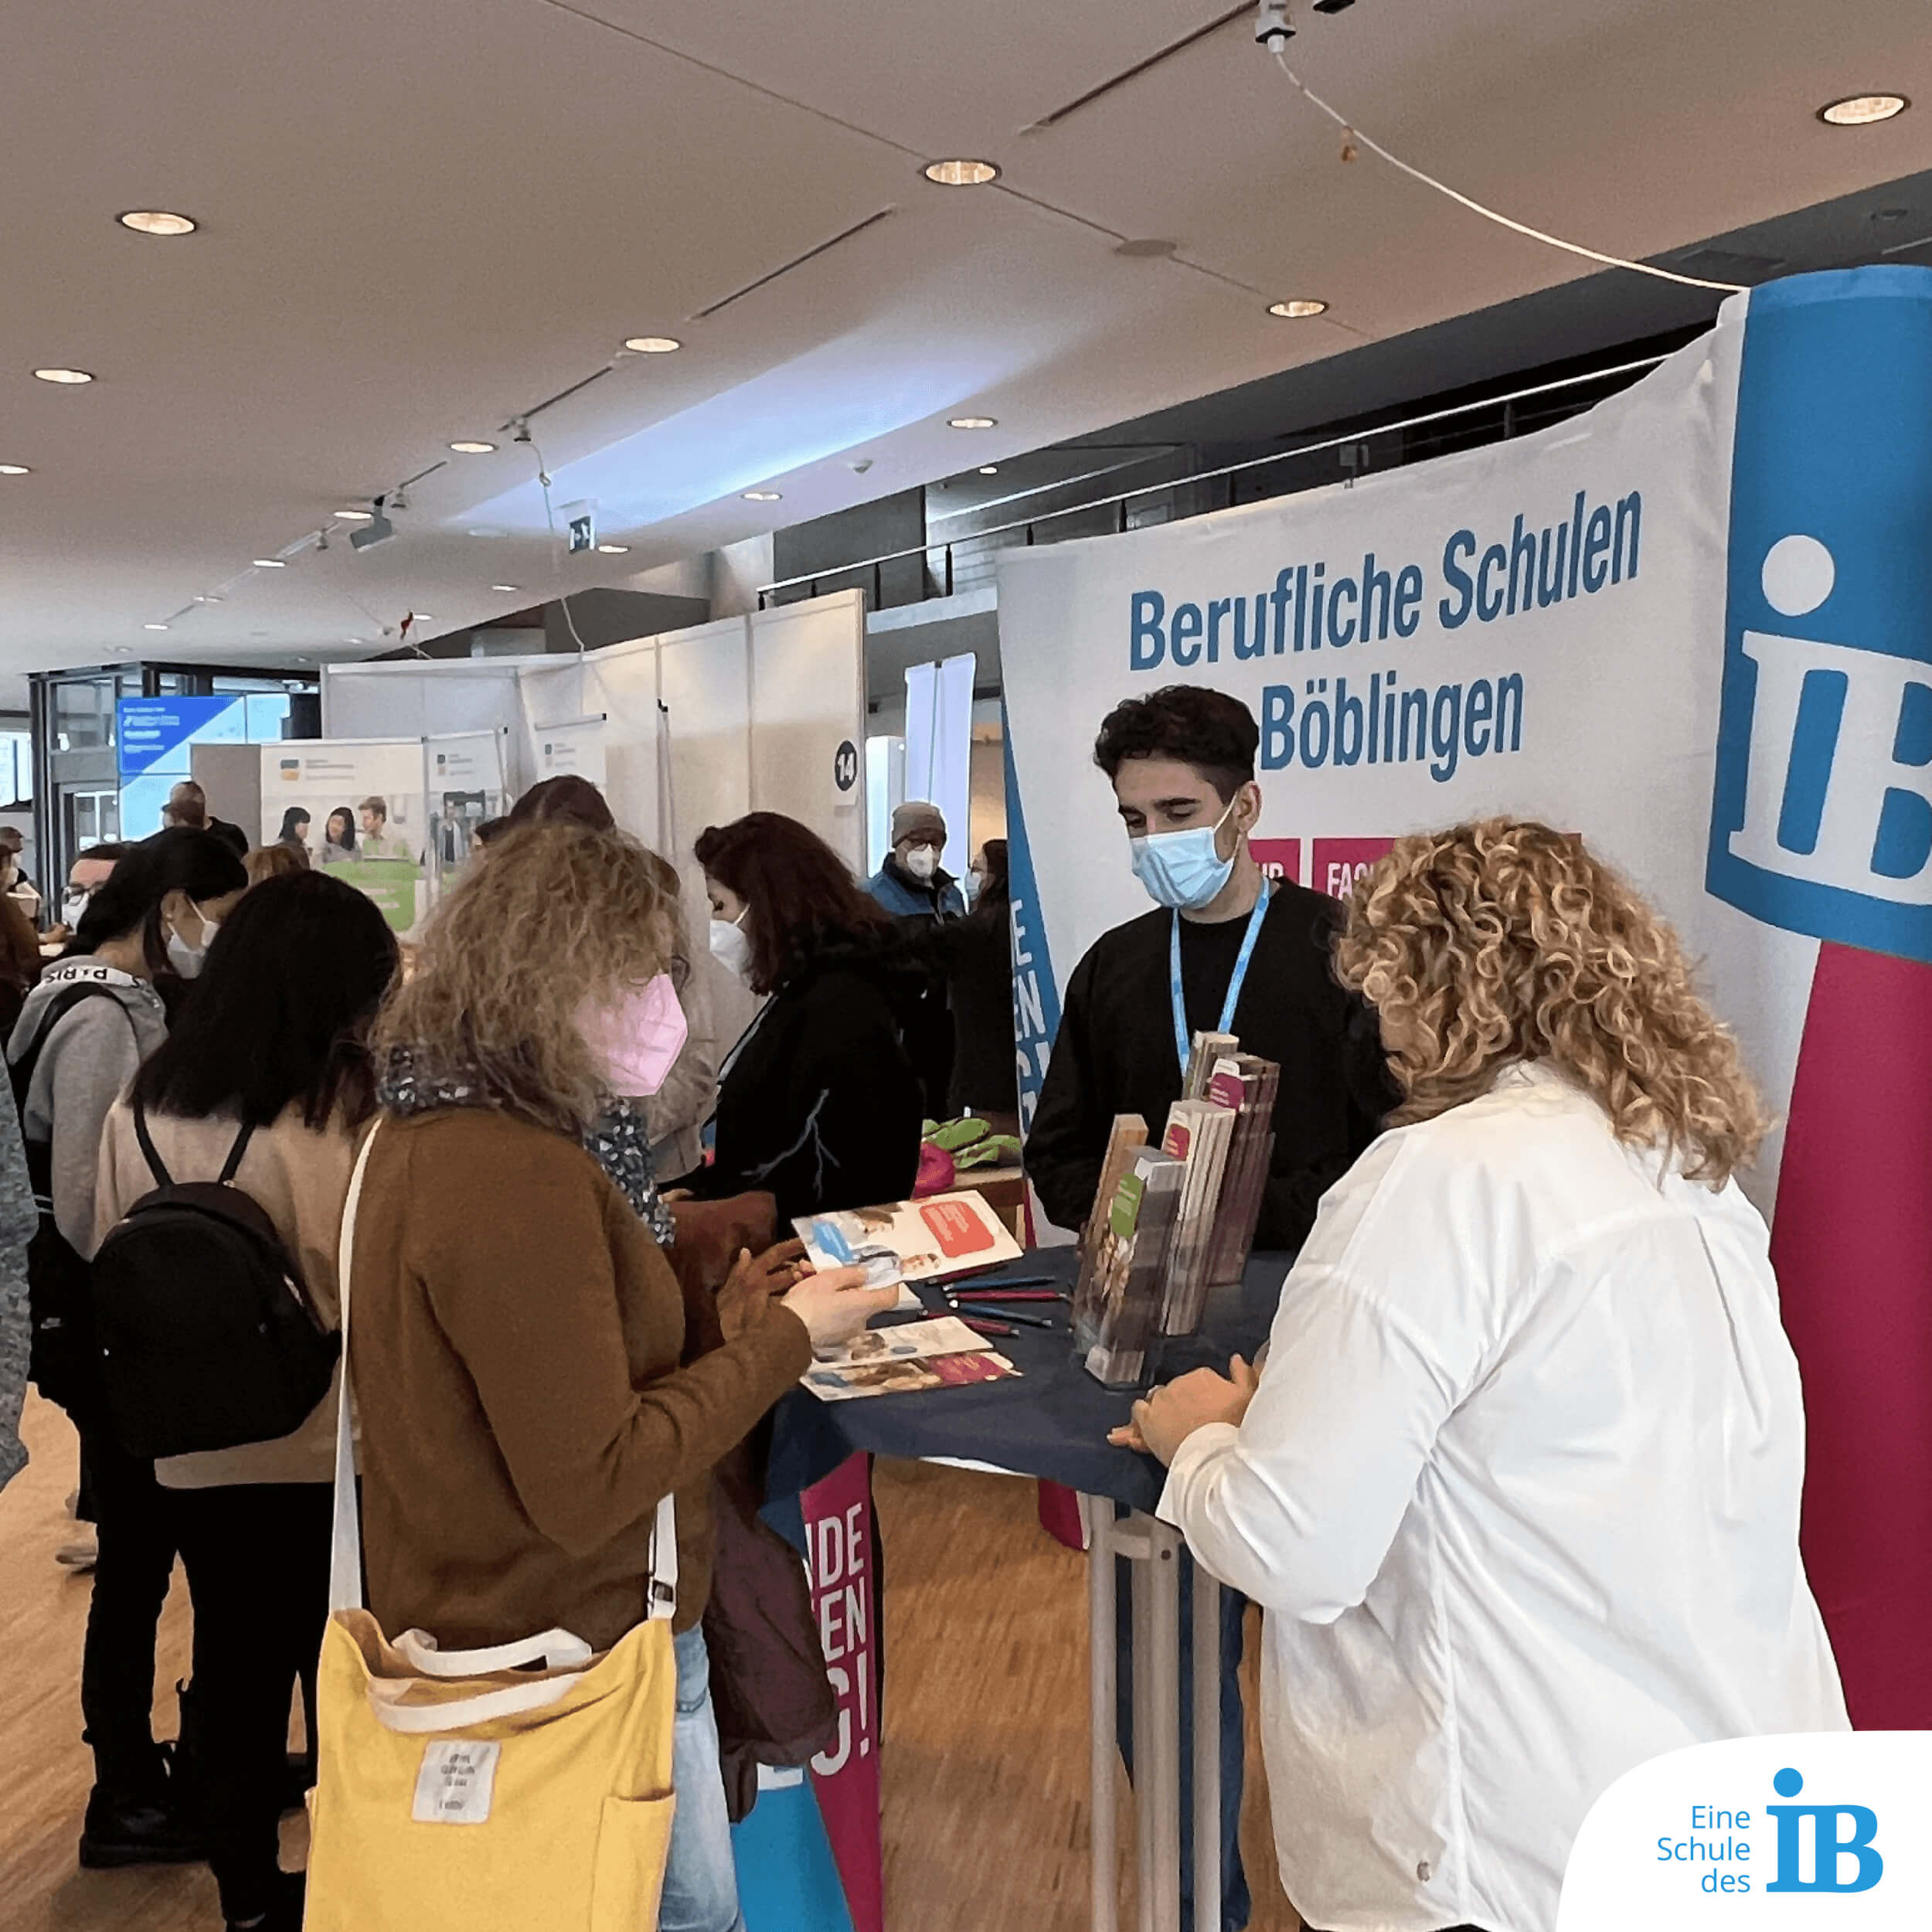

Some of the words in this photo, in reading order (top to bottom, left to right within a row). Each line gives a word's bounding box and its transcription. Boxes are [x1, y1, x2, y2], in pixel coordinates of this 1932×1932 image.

[1129, 553, 1423, 671] Berufliche
[1438, 490, 1641, 630] Schulen
[838, 753, 855, 781] 14
[1260, 670, 1524, 782] Böblingen
